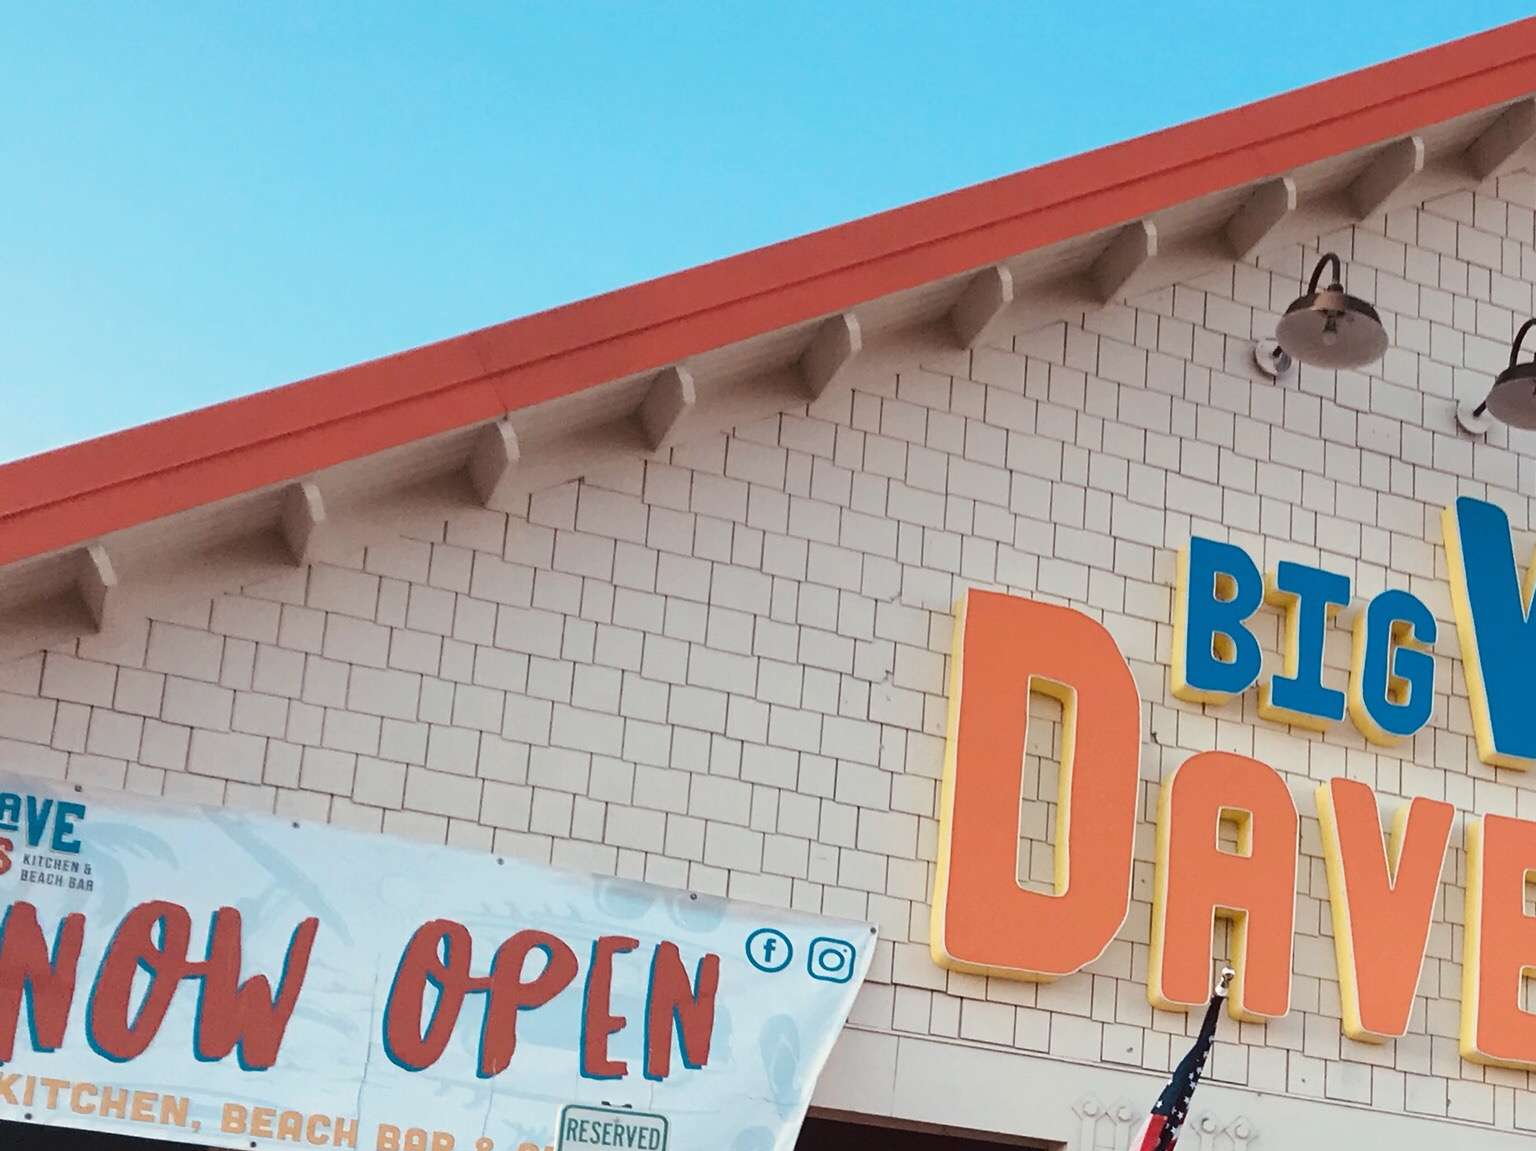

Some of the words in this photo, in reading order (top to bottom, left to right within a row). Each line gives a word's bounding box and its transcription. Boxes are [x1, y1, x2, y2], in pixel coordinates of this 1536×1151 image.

[1172, 536, 1437, 747] BIG
[20, 869, 63, 887] BEACH
[68, 878, 94, 893] BAR
[23, 854, 80, 873] KITCHEN
[0, 900, 320, 1072] NOW
[382, 919, 720, 1081] OPEN
[0, 1071, 202, 1133] KITCHEN,
[221, 1102, 358, 1149] BEACH
[566, 1117, 661, 1151] RESERVED
